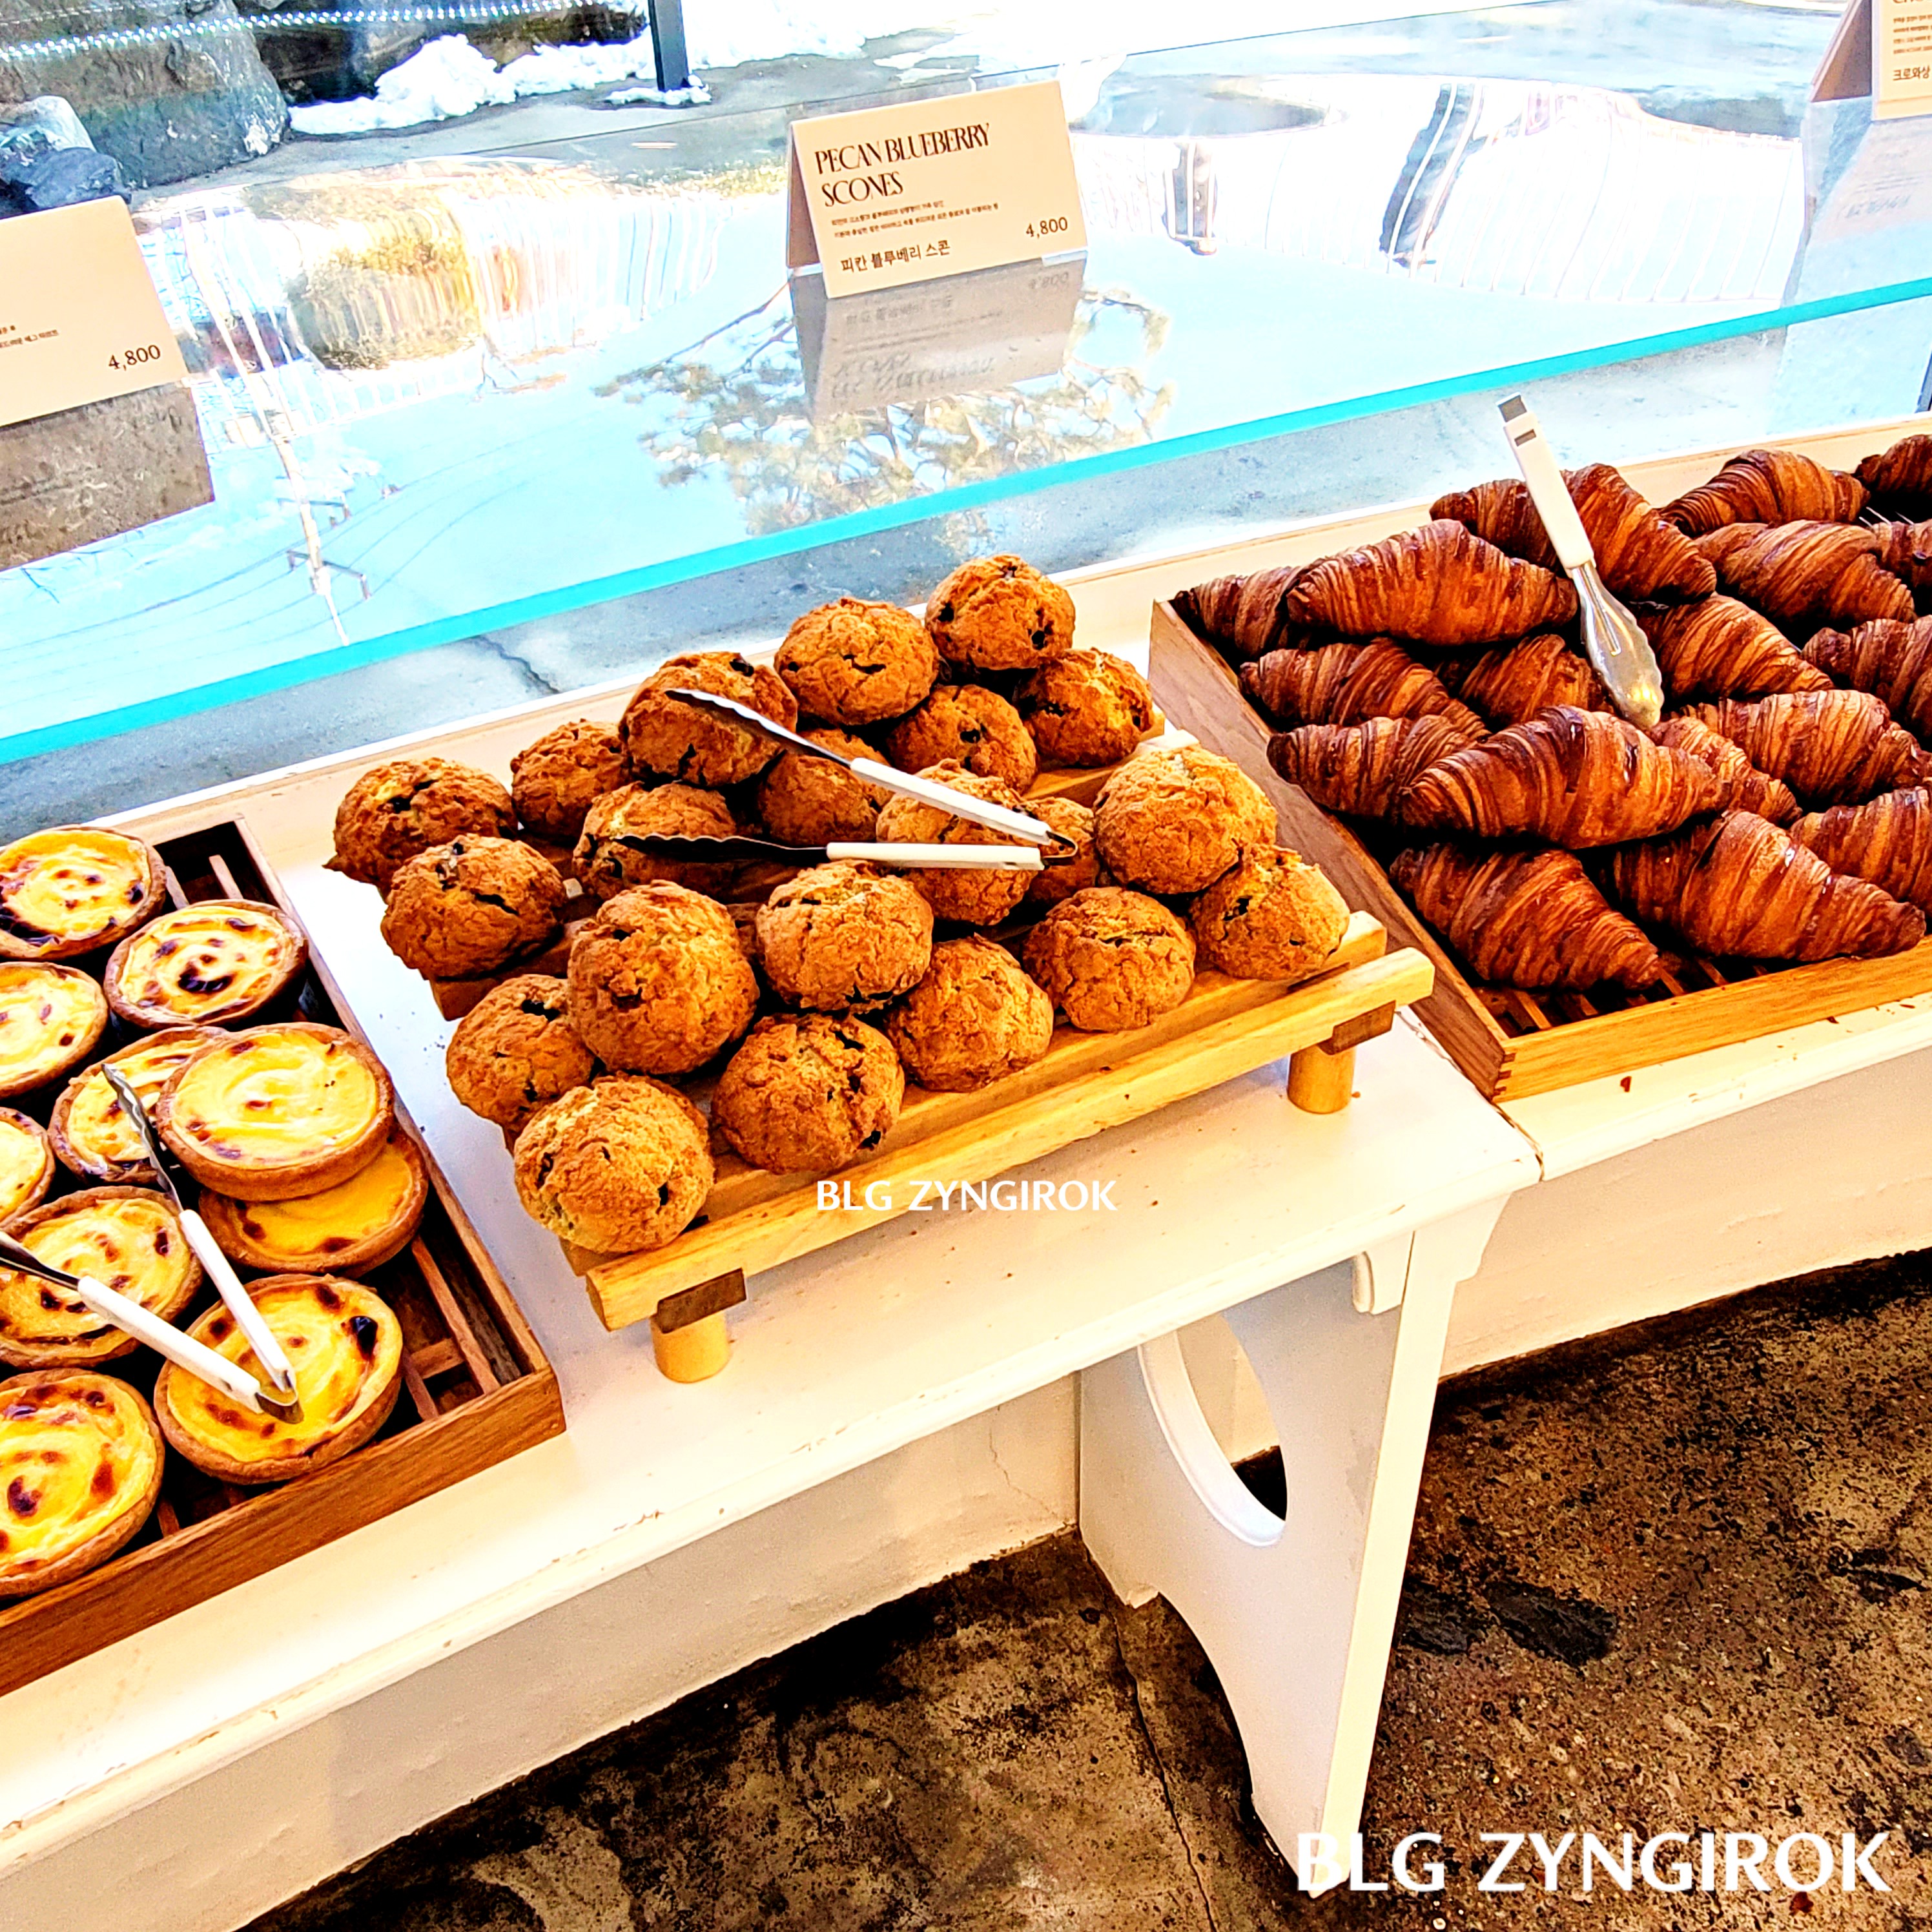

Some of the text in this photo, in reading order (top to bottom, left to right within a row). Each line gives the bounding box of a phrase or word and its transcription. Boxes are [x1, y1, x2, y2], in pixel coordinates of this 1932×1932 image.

[1893, 65, 1931, 81] 크로와상
[814, 122, 990, 175] PECAN BLUEBERRY
[821, 171, 904, 207] SCONES
[1025, 216, 1069, 239] 4,800
[840, 240, 951, 272] 피칸 블루베리 스콘
[108, 344, 161, 371] 4,800
